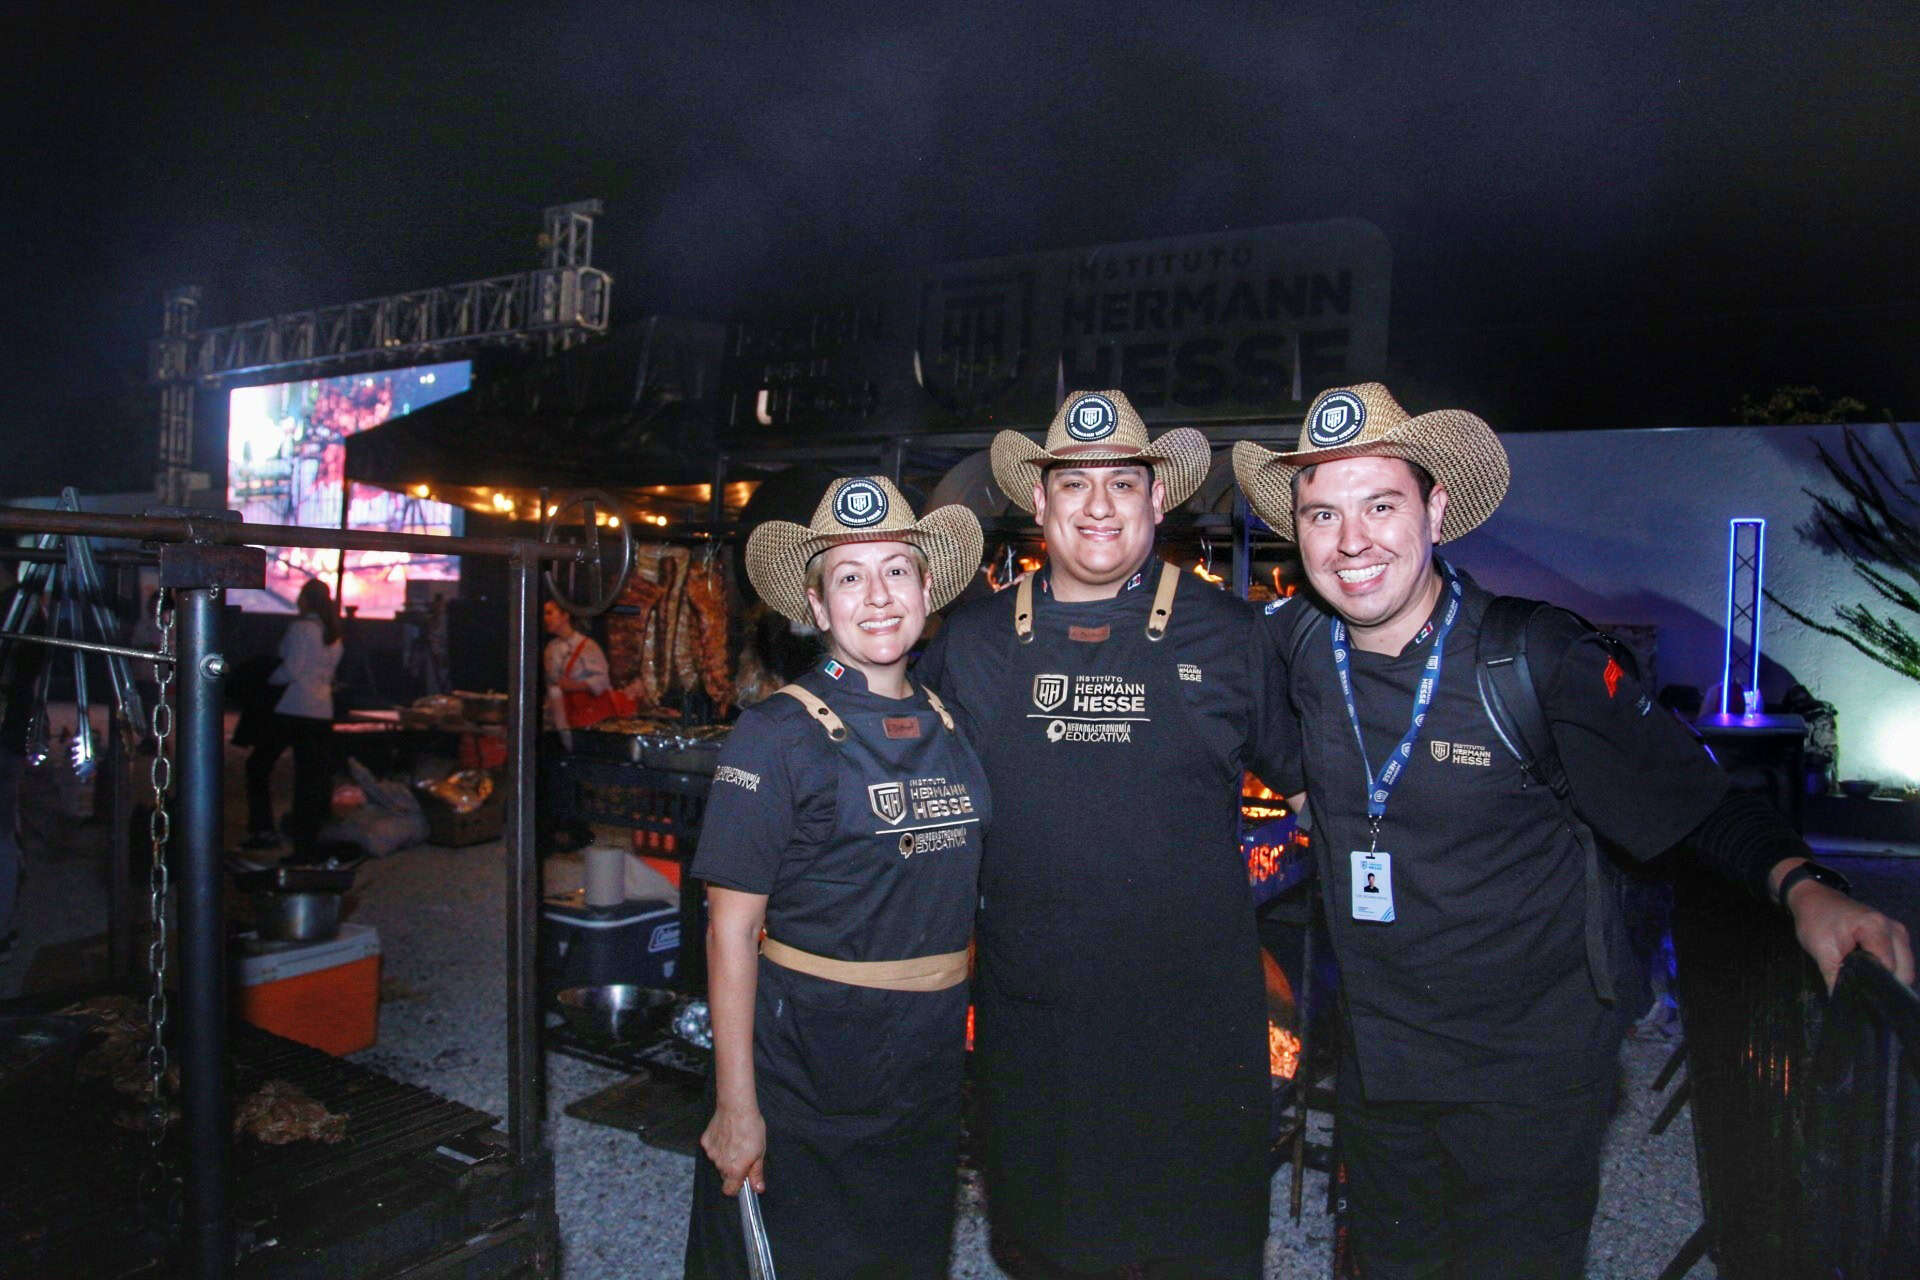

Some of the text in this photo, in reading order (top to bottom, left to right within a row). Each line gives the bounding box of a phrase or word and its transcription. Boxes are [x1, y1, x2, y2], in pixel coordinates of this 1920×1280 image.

[1070, 248, 1251, 283] INSTITUTO
[1062, 270, 1352, 336] HERMANN
[1066, 326, 1352, 408] HESSE
[1076, 675, 1123, 683] INSTITUTO
[1179, 673, 1202, 682] ESSE
[1075, 683, 1145, 695] HERMANN
[1418, 678, 1428, 704] HESSE
[1073, 695, 1145, 713] HESSE
[1065, 731, 1131, 743] EDUCATIVA
[1452, 747, 1491, 758] HERMANN
[1452, 754, 1491, 767] HESSE
[1382, 759, 1398, 784] HESSE
[909, 777, 946, 787] INSTITUTO
[910, 783, 968, 800] HERMANN
[912, 795, 974, 820] HESSE
[915, 837, 968, 855] EDUCATIVA
